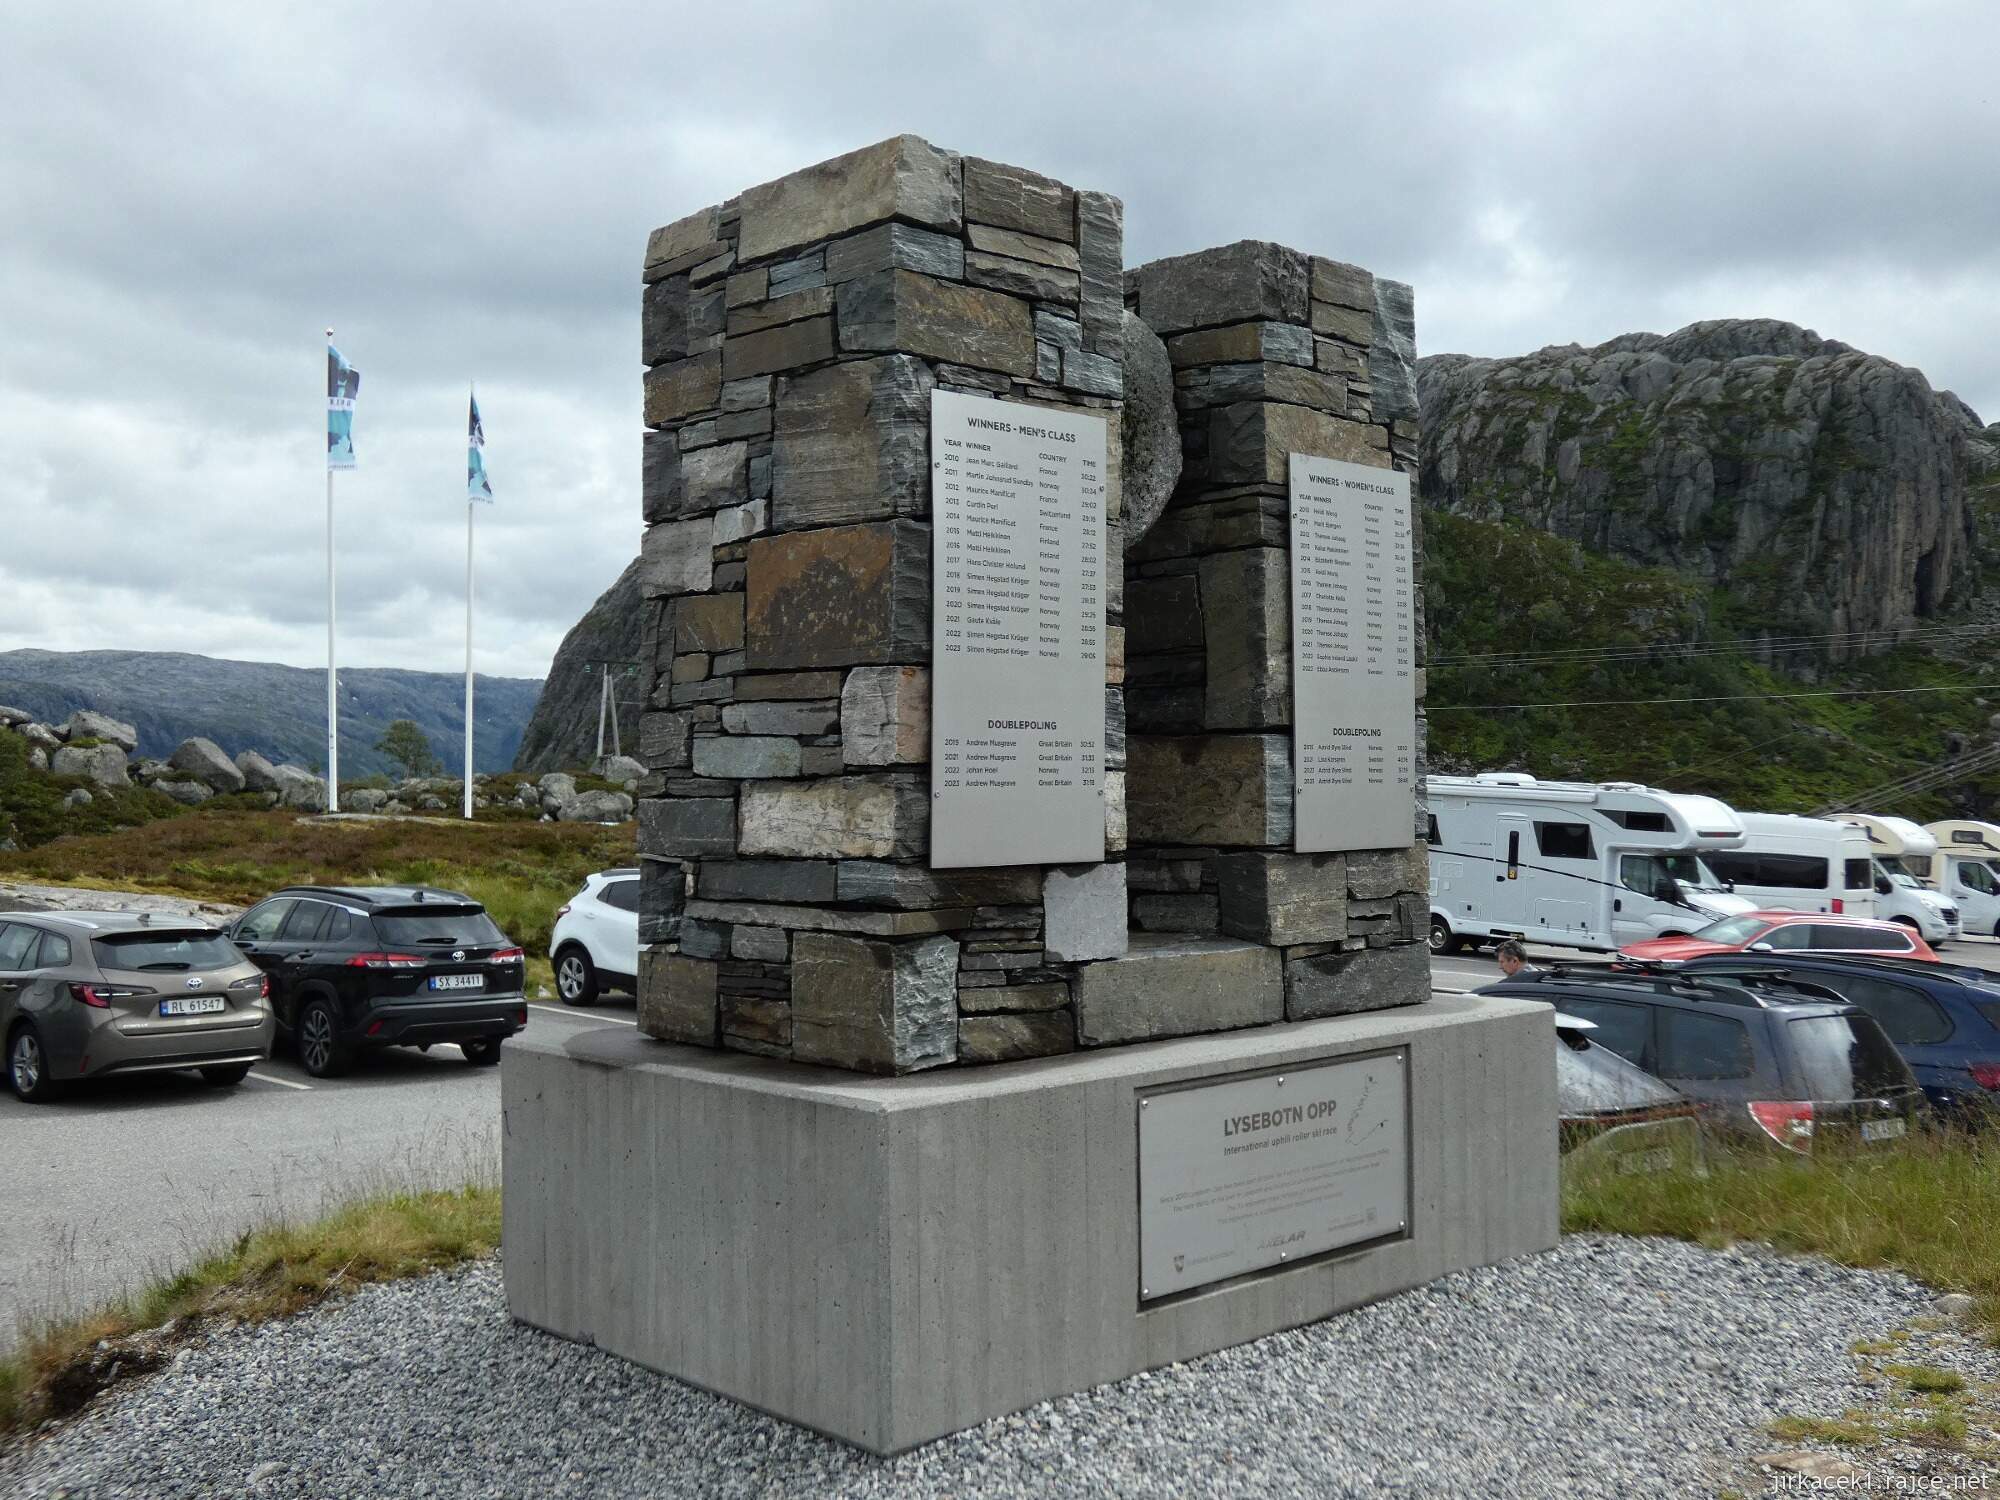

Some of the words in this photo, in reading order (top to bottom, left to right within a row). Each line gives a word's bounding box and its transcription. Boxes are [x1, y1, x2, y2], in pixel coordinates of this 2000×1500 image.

[968, 417, 1011, 432] WINNERS
[1020, 425, 1046, 438] MEN'S
[1048, 430, 1076, 443] CLASS
[944, 438, 962, 447] YEAR
[966, 441, 991, 451] WINNER
[1039, 452, 1067, 463] COUNTRY
[1082, 459, 1096, 468] TIME
[945, 453, 959, 462] 2010
[945, 468, 958, 476] 2011
[945, 482, 959, 491] 2012
[1309, 473, 1339, 487] WINNERS
[1345, 480, 1374, 492] WOMEN'S
[1376, 485, 1394, 495] CLASS
[1299, 493, 1312, 501] YEAR
[946, 512, 960, 520] 2014
[946, 556, 960, 564] 2017
[988, 719, 1057, 730] DOUBLEPOLING
[1333, 727, 1382, 737] DOUBLEPOLING
[966, 739, 988, 747] Andrew
[945, 766, 960, 774] 2022
[440, 976, 451, 987] SX
[455, 974, 480, 985] 34411
[172, 1002, 185, 1012] RL
[190, 999, 221, 1011] 61547
[1224, 1105, 1303, 1137] LYSEBOTN
[1307, 1100, 1337, 1120] OPP
[1224, 1140, 1270, 1156] International
[1272, 1134, 1291, 1148] uphill
